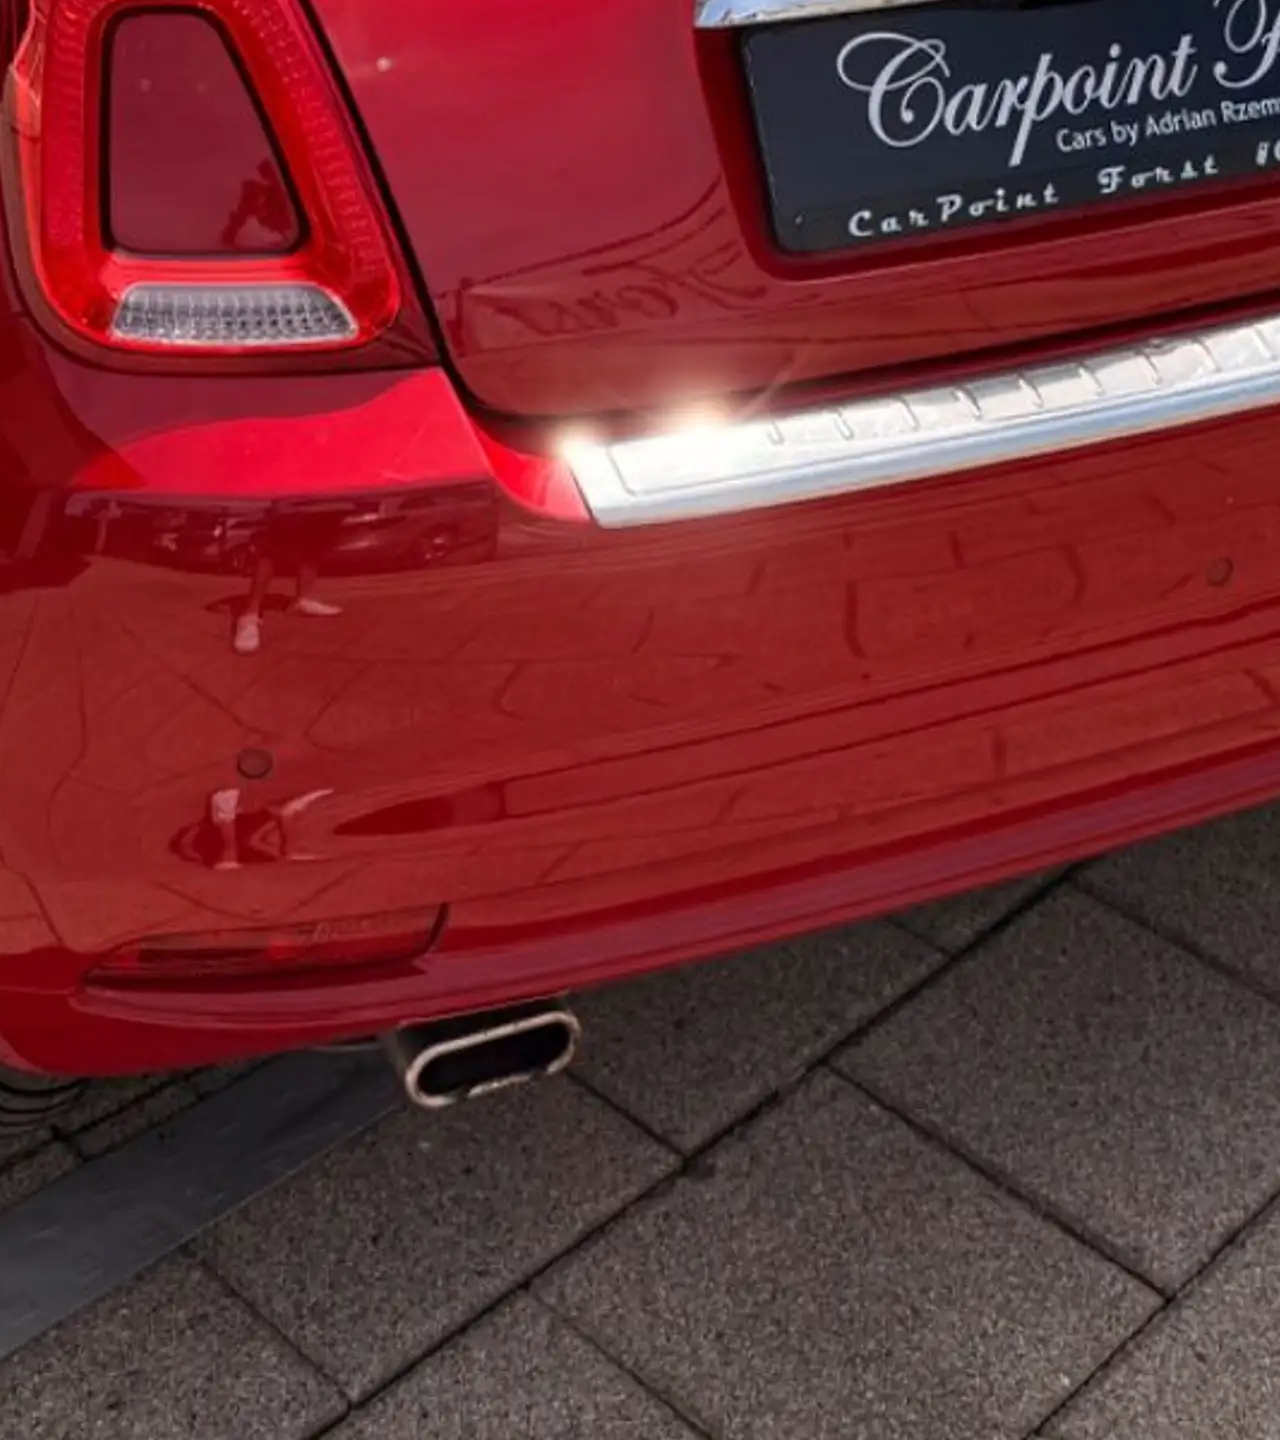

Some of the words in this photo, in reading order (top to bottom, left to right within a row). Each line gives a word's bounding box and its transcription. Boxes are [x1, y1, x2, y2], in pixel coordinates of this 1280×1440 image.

[836, 31, 1198, 167] Carpoint
[1056, 127, 1106, 152] Cars
[1110, 120, 1139, 146] by
[1145, 108, 1217, 137] Adrian
[848, 182, 1060, 237] CarPoint
[1097, 154, 1220, 194] Forst
